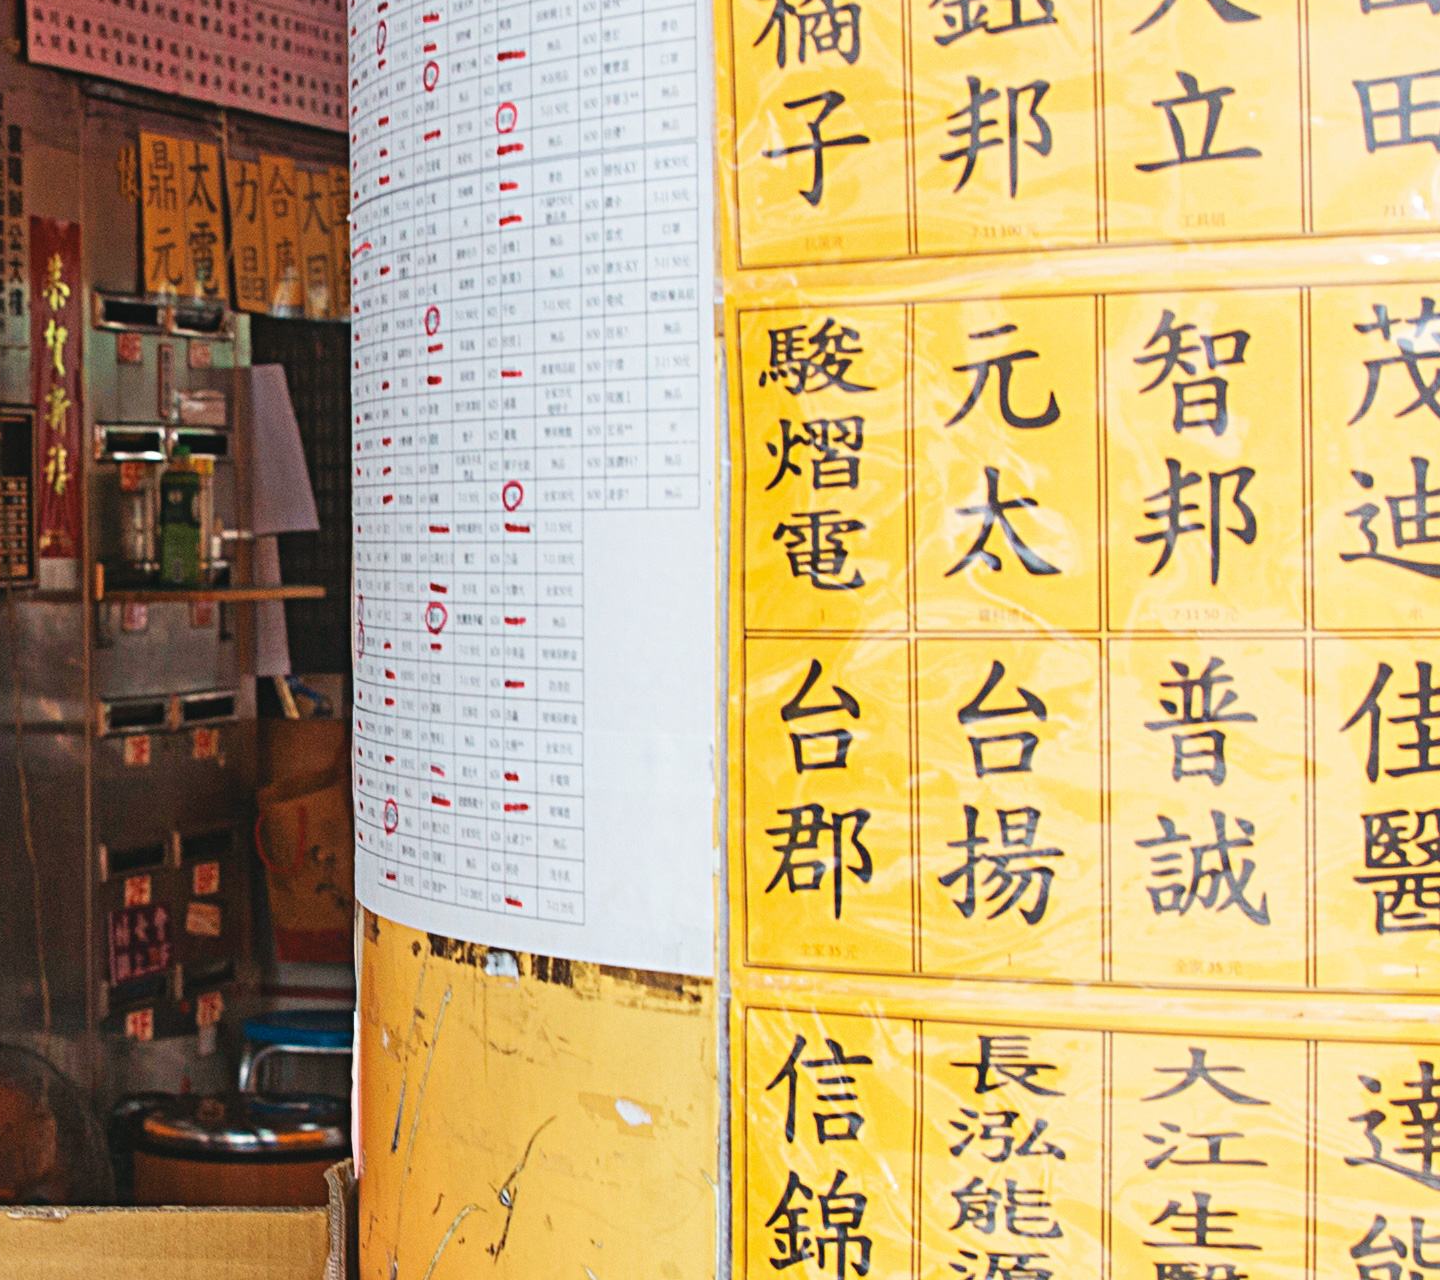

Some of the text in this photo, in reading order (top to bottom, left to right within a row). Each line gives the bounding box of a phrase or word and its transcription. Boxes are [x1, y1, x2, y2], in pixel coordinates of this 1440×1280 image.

[758, 316, 877, 591] 駿熠電
[943, 323, 1062, 580] 元太
[1132, 309, 1259, 586] 智邦
[764, 659, 874, 920] 台郡
[937, 659, 1066, 926] 台揚
[1133, 655, 1271, 926] 普誠
